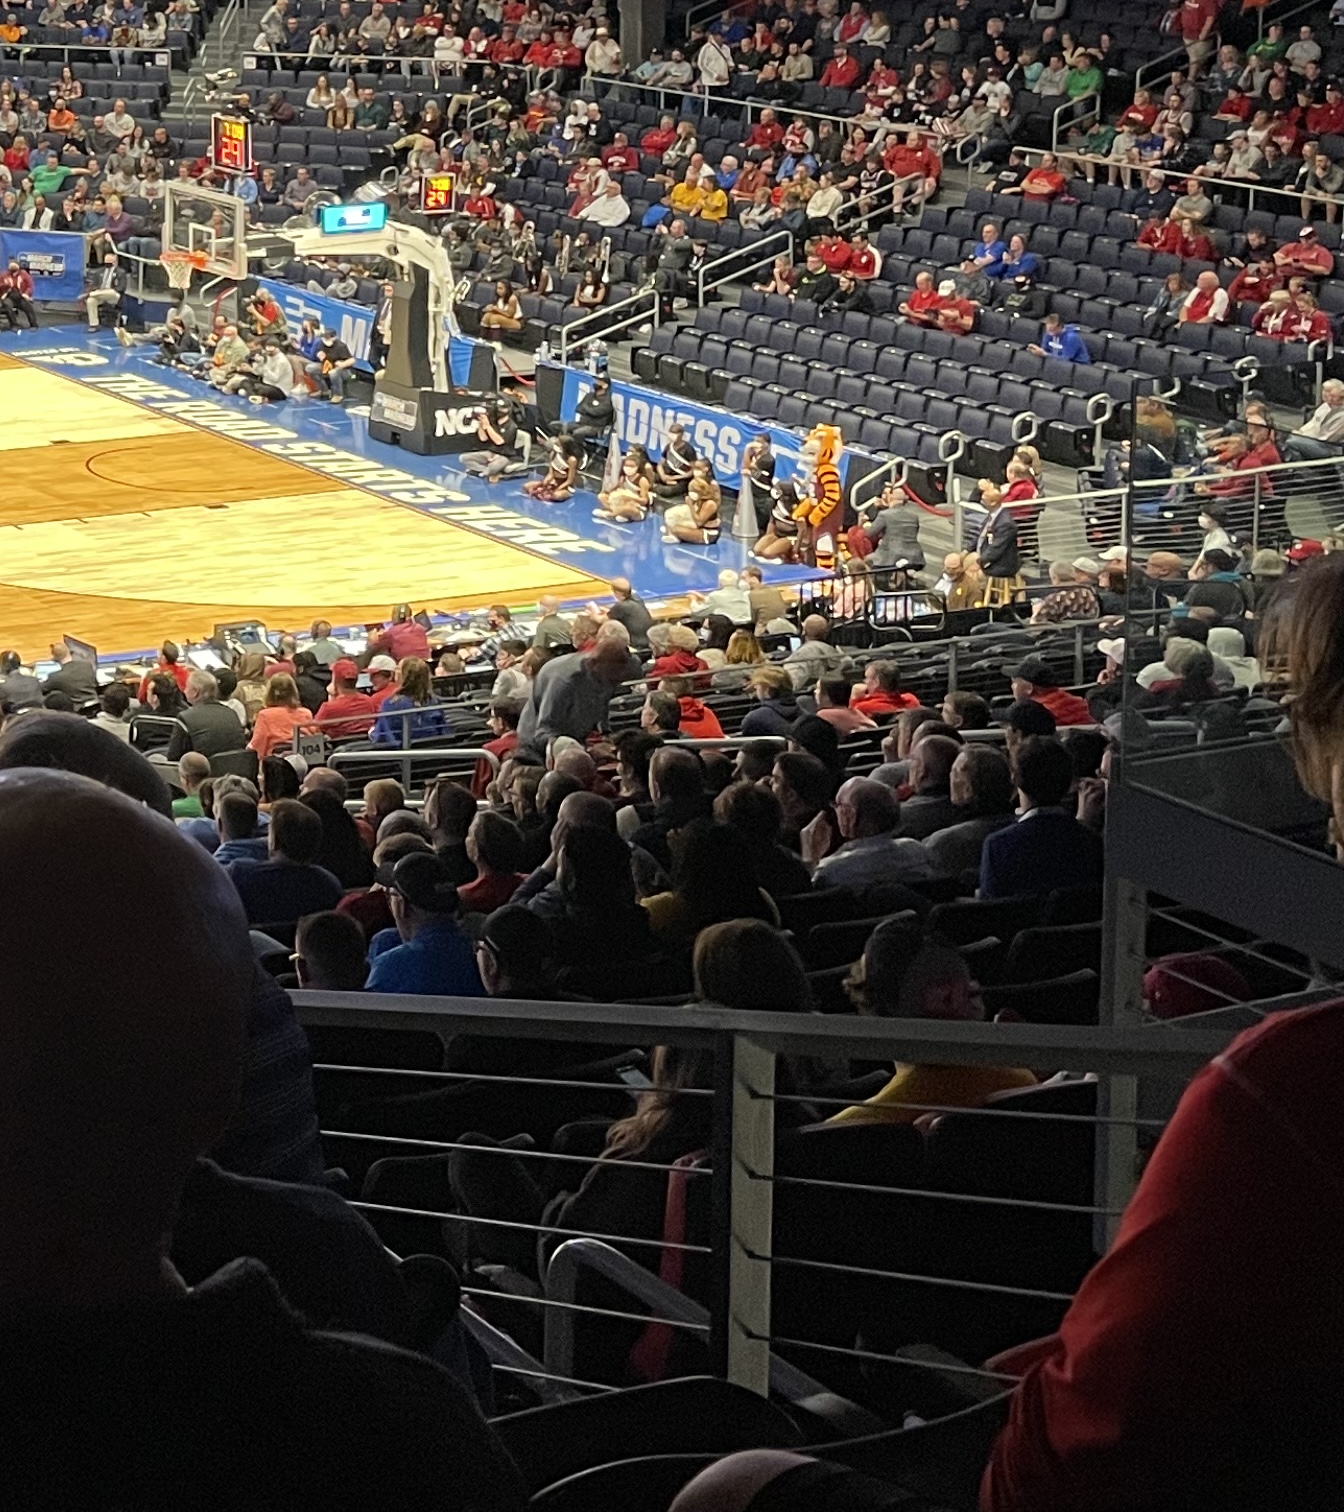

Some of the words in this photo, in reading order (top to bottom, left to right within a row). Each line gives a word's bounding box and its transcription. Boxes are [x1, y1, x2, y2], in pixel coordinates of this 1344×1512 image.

[222, 137, 242, 166] 29
[79, 373, 191, 401] THE
[172, 399, 299, 441] ROAD
[261, 441, 472, 503] STARTS
[430, 504, 616, 555] HERE
[301, 744, 321, 756] 104
